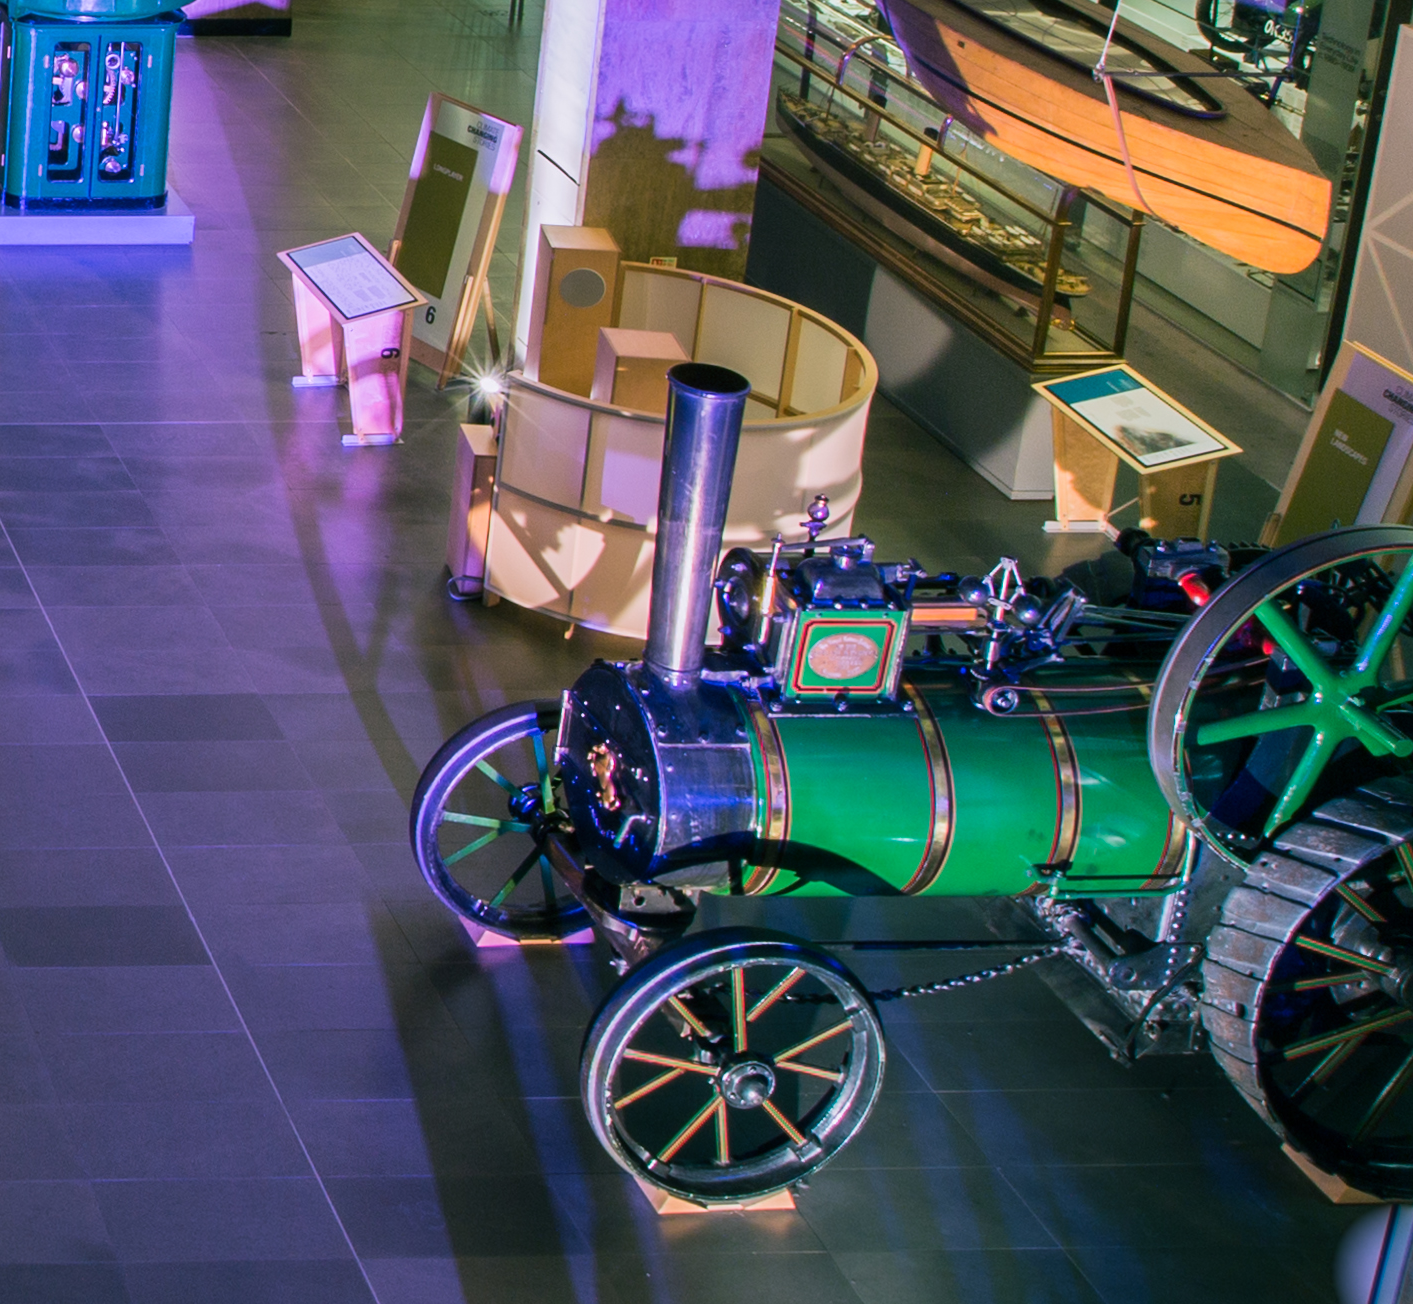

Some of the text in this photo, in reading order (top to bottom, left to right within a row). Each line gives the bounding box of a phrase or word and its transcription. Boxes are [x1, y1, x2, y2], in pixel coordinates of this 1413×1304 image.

[467, 124, 498, 144] CHANGING
[425, 306, 436, 325] 6
[380, 347, 400, 359] 6
[1179, 493, 1201, 506] 5
